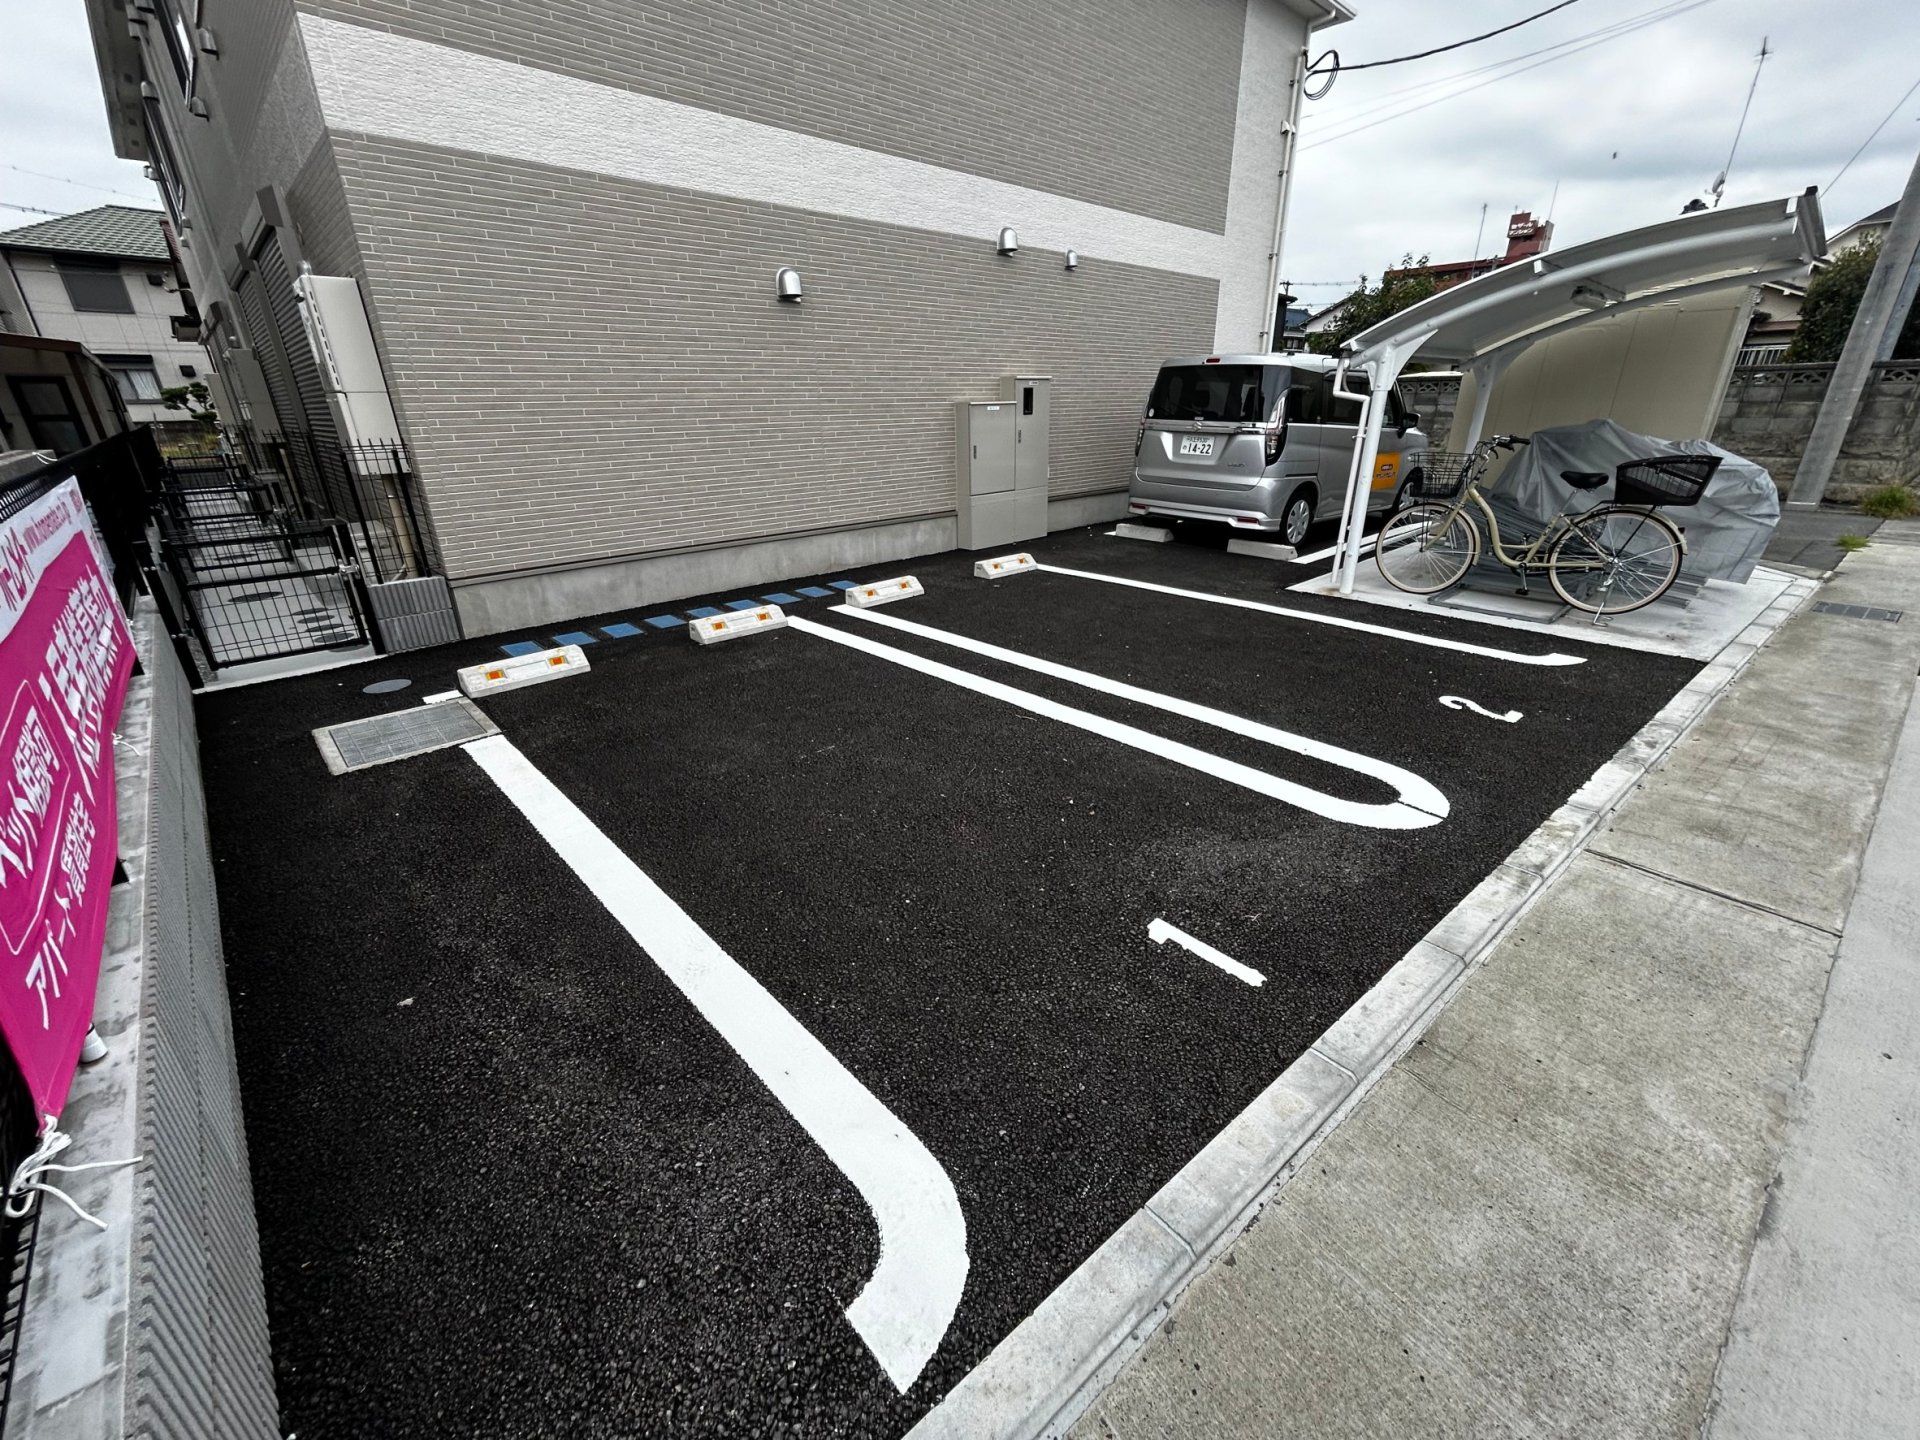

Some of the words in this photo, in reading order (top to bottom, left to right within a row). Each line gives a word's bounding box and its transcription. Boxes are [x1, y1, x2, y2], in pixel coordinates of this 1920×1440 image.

[1188, 443, 1211, 454] 14-22
[38, 564, 122, 806] 入居者様募集中
[1438, 695, 1523, 723] 2
[1147, 917, 1267, 987] 1
